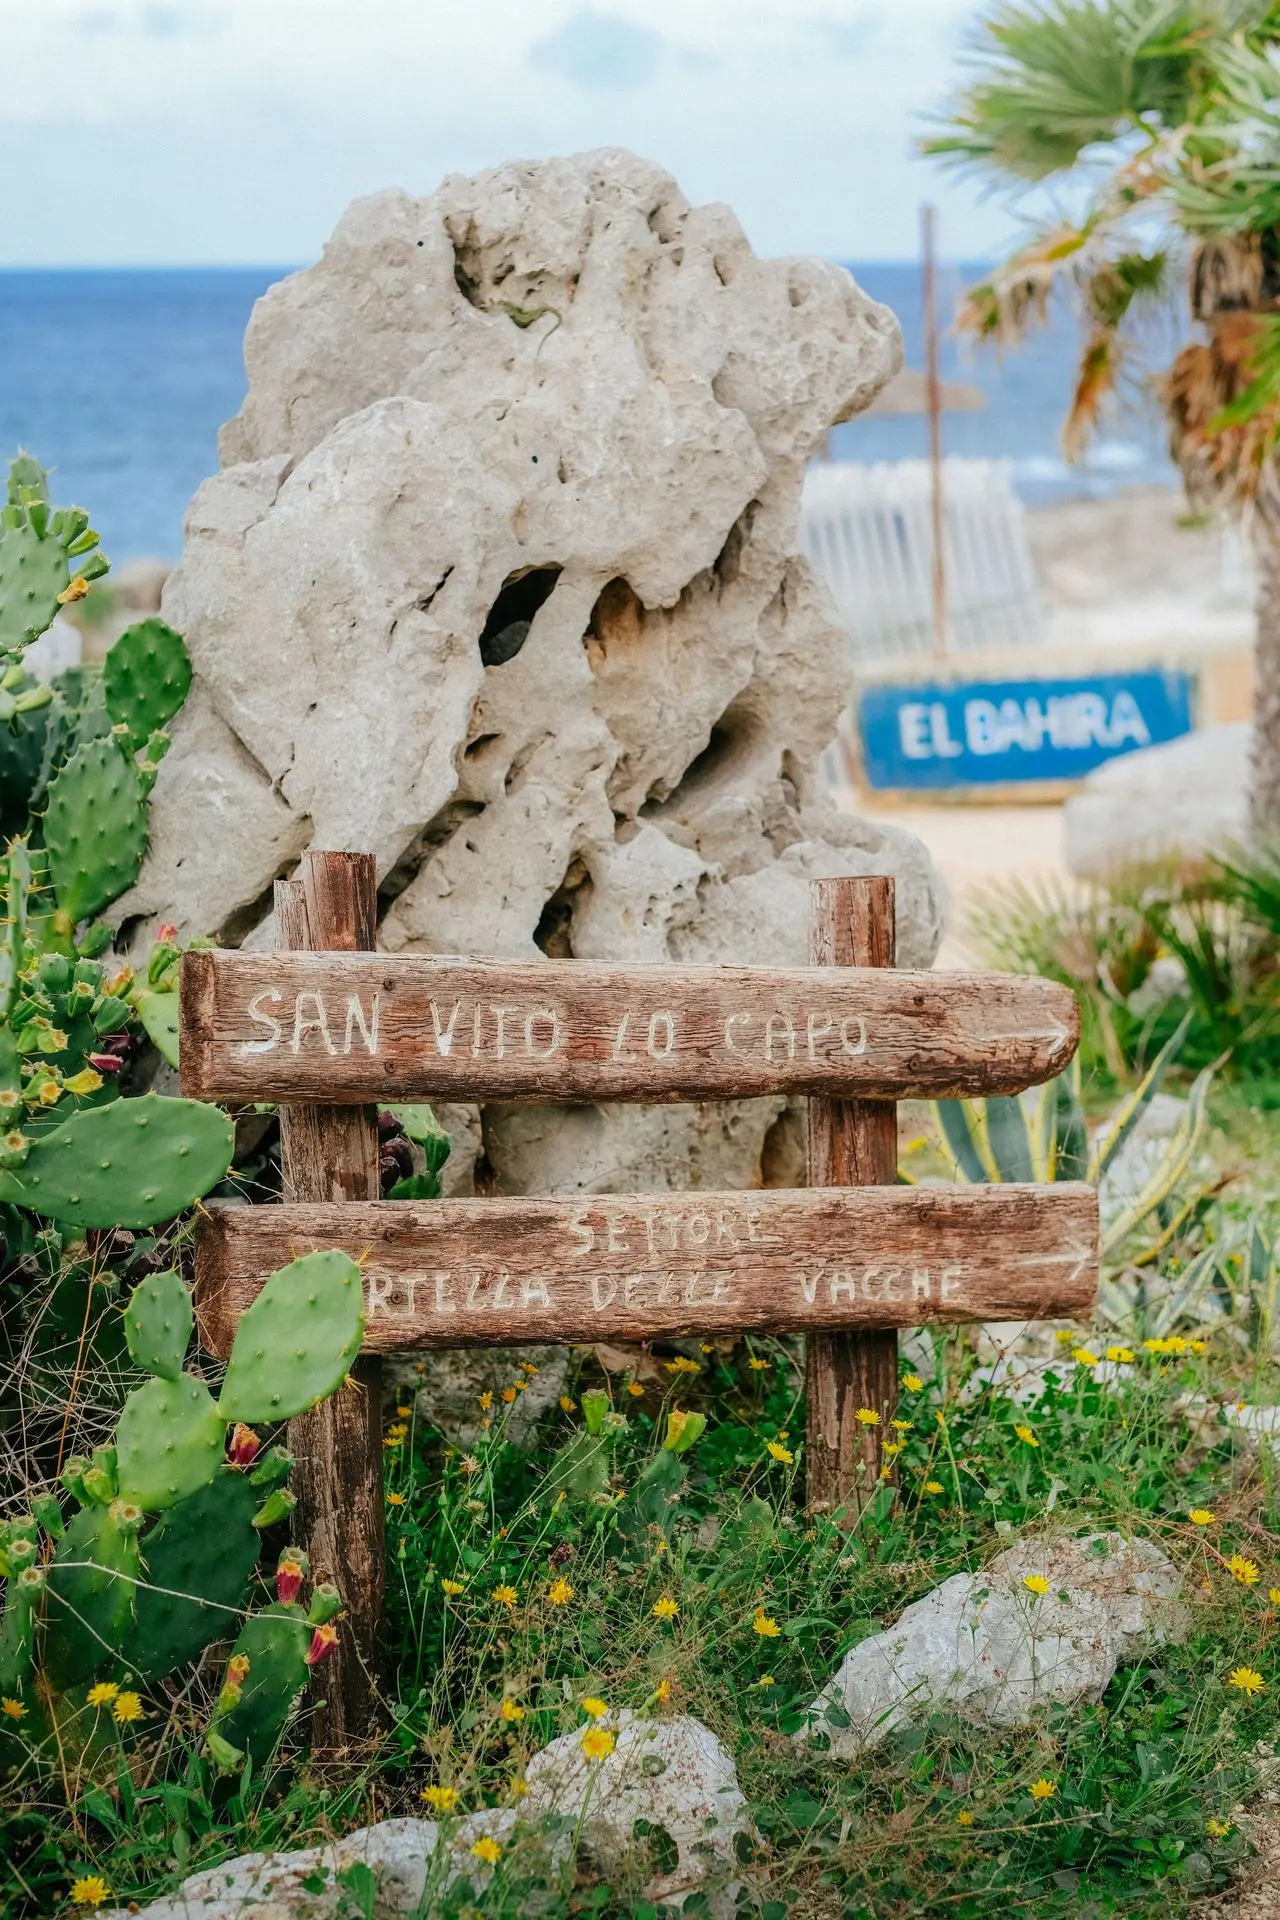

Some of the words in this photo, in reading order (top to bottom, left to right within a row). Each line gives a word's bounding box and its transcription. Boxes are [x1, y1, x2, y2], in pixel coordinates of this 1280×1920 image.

[898, 701, 964, 760] EL
[964, 689, 1154, 757] BAHIRA
[230, 986, 380, 1060] SAN
[428, 996, 562, 1060] VITO
[612, 1008, 675, 1063] LO
[724, 1008, 868, 1062] CAPO
[569, 1206, 771, 1256] SETTORE
[365, 1268, 552, 1319] RTELLA
[590, 1268, 739, 1313] DELLE
[797, 1265, 964, 1305] VACCHE
